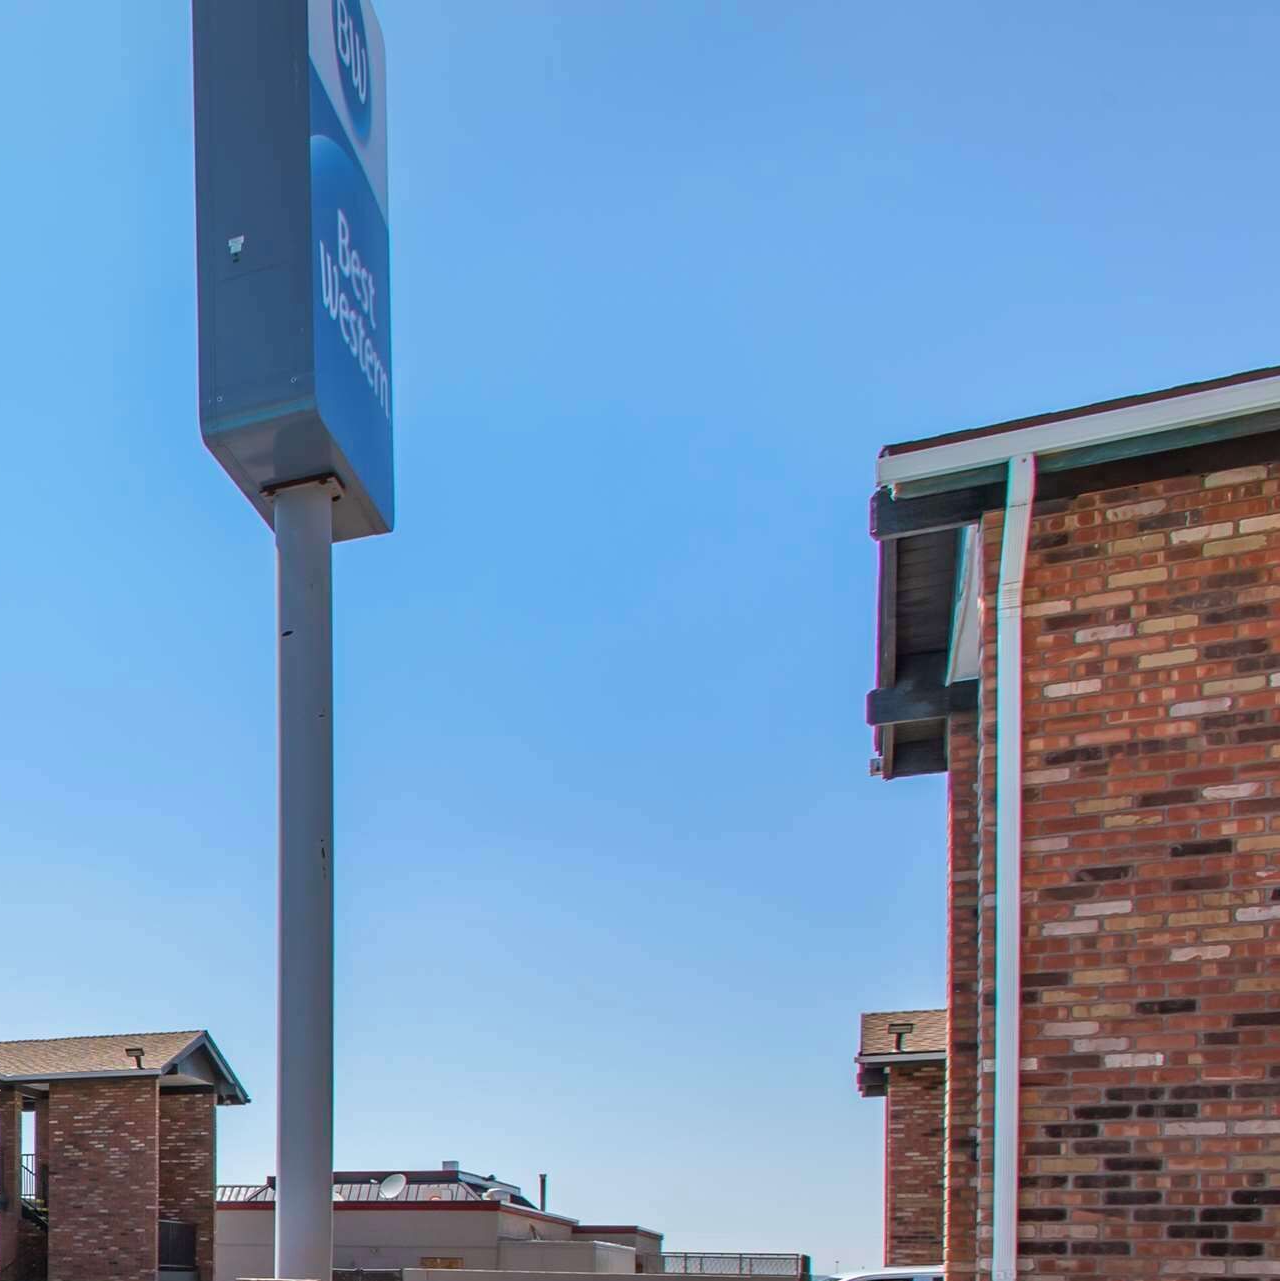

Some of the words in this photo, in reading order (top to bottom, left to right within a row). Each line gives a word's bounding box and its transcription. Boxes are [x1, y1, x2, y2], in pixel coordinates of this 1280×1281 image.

[337, 0, 367, 104] BW
[319, 238, 390, 420] Western
[337, 207, 377, 330] Best
